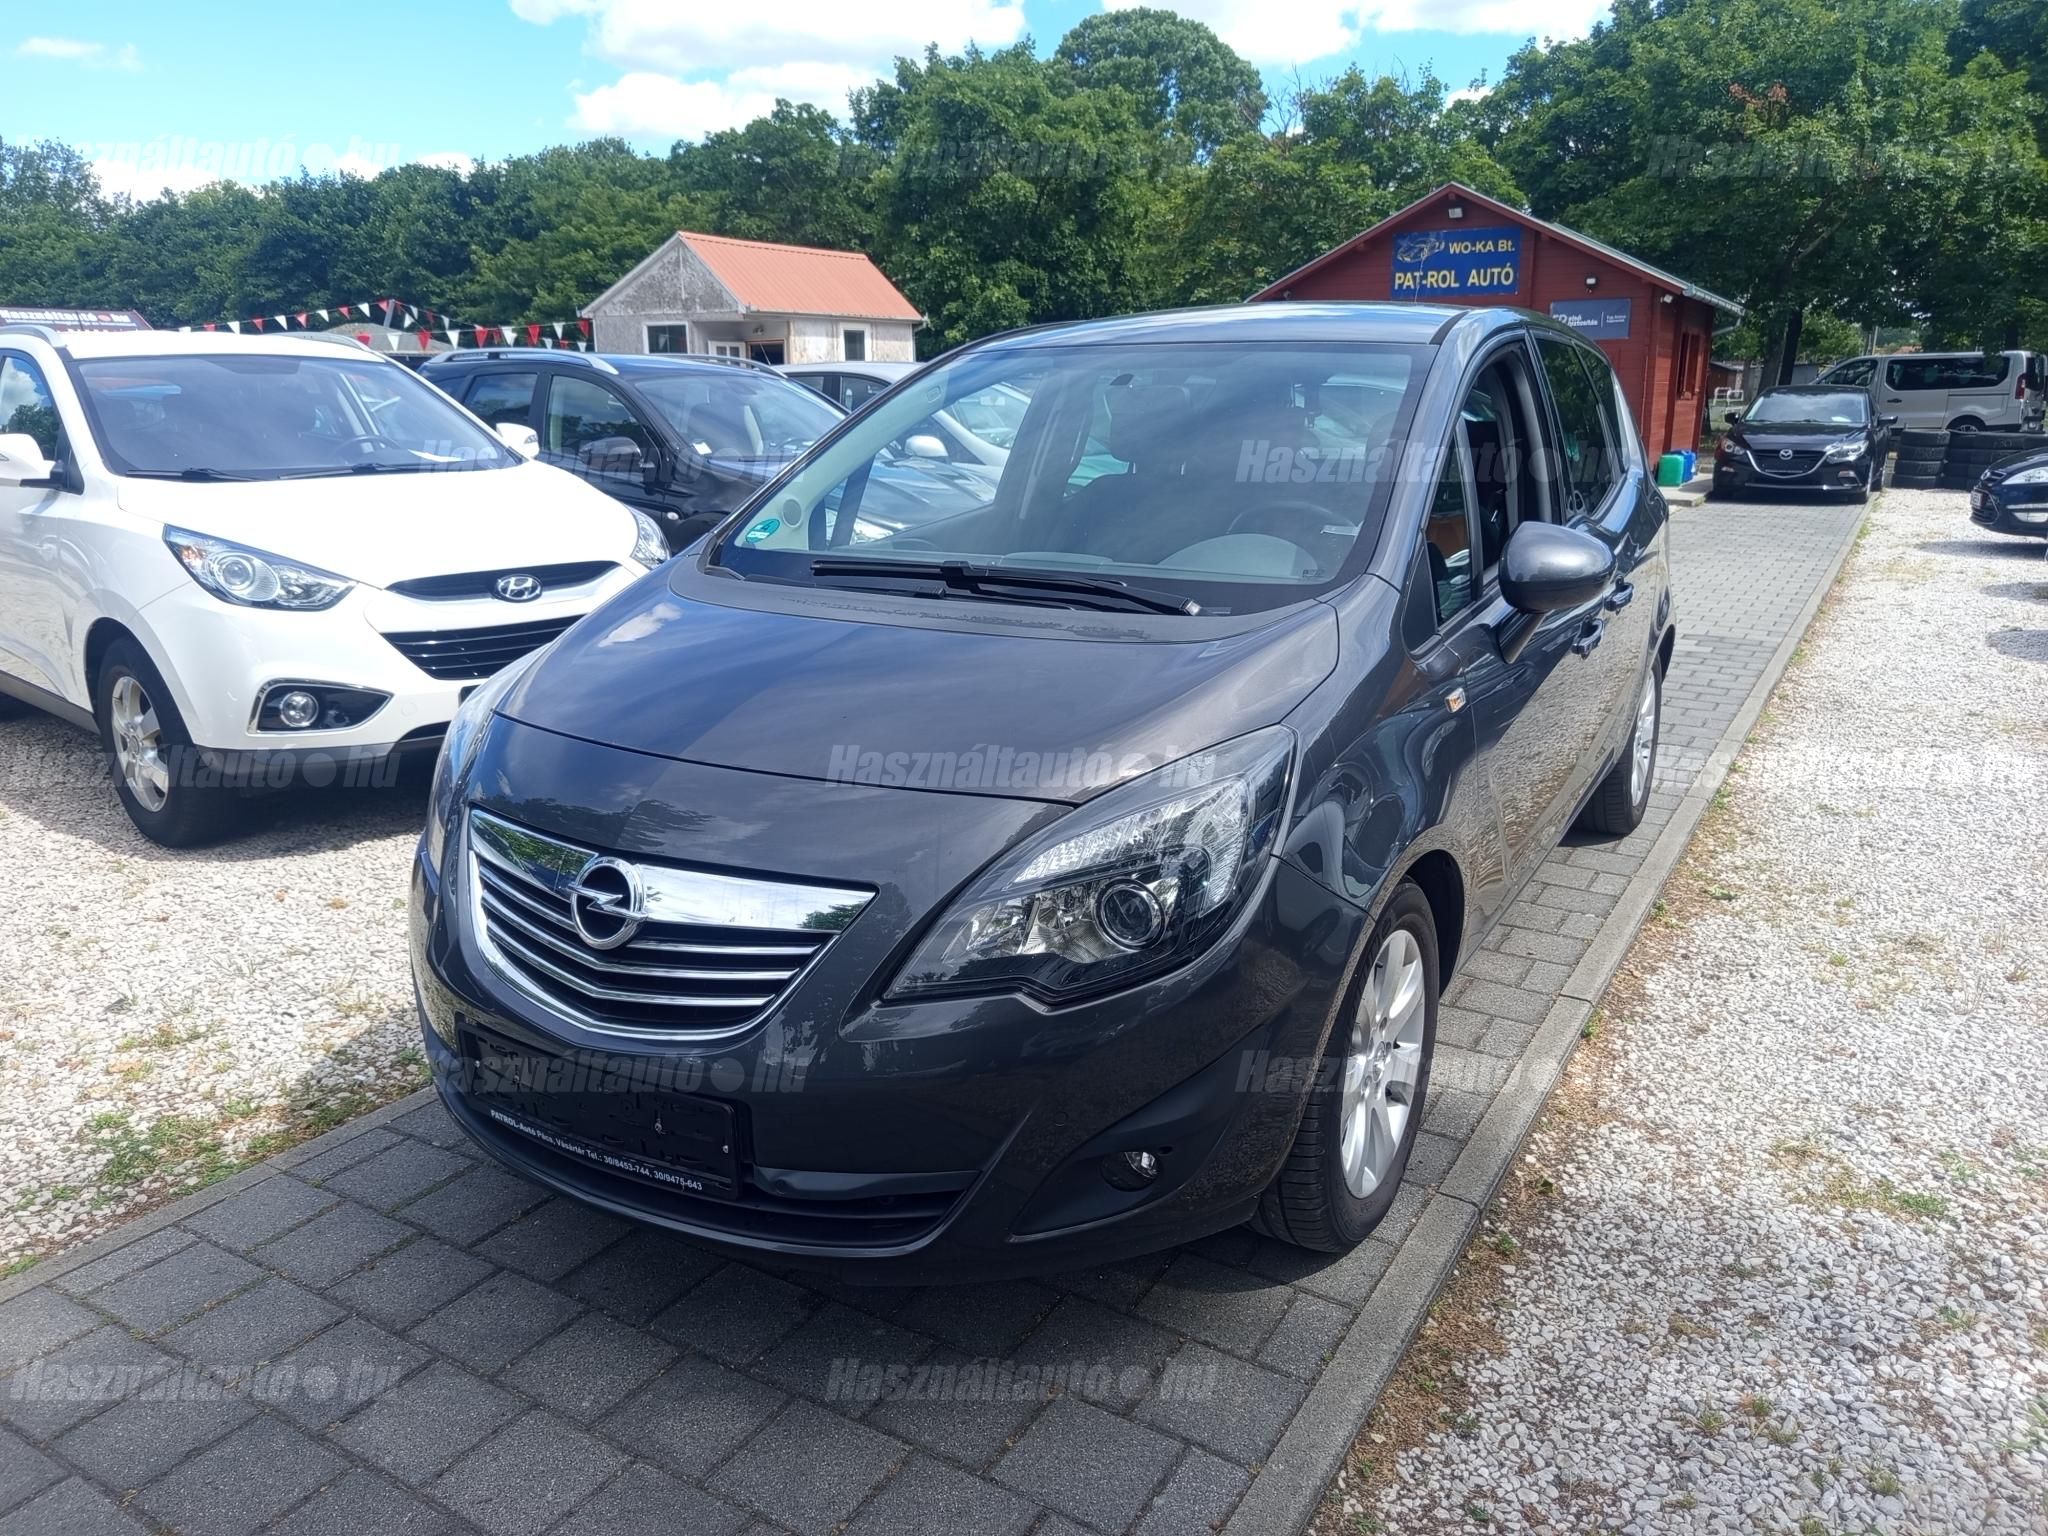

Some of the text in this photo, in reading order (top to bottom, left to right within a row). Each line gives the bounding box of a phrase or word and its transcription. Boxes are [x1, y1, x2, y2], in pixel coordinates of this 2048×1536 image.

[1449, 239, 1516, 254] WO-KA Bt.
[1394, 262, 1514, 290] PAT-ROL AUTÓ
